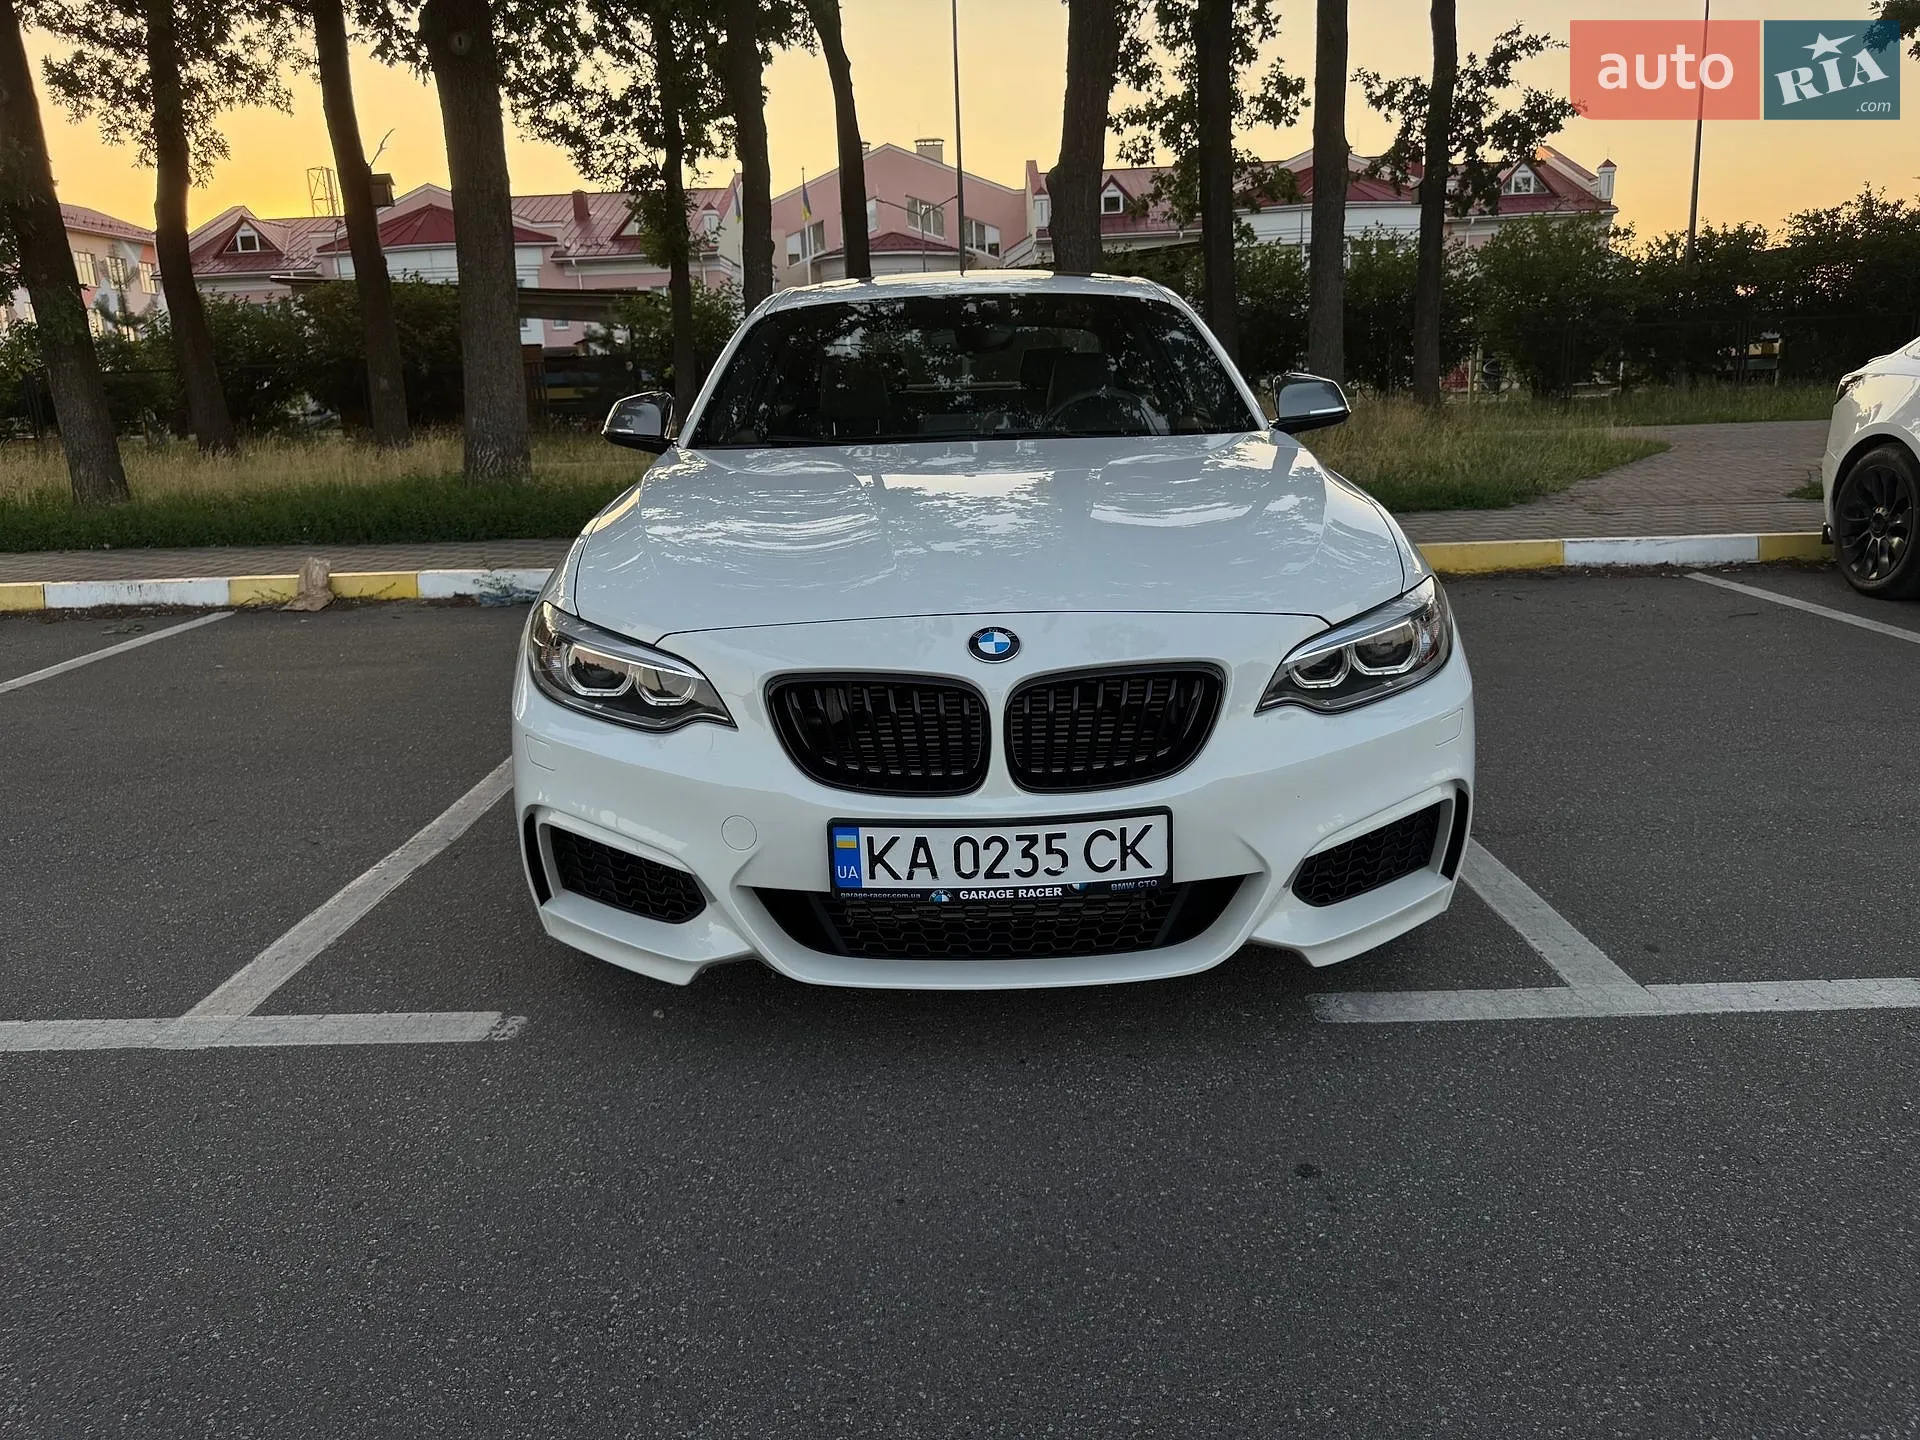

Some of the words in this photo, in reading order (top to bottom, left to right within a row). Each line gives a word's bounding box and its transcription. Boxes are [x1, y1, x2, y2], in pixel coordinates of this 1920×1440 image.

[867, 836, 940, 881] KA
[953, 832, 1069, 879] 0235
[1083, 824, 1153, 873] CK
[837, 866, 859, 879] UA
[1111, 882, 1135, 890] BMW
[959, 890, 1015, 900] GARAGE
[1018, 887, 1063, 898] RACER
